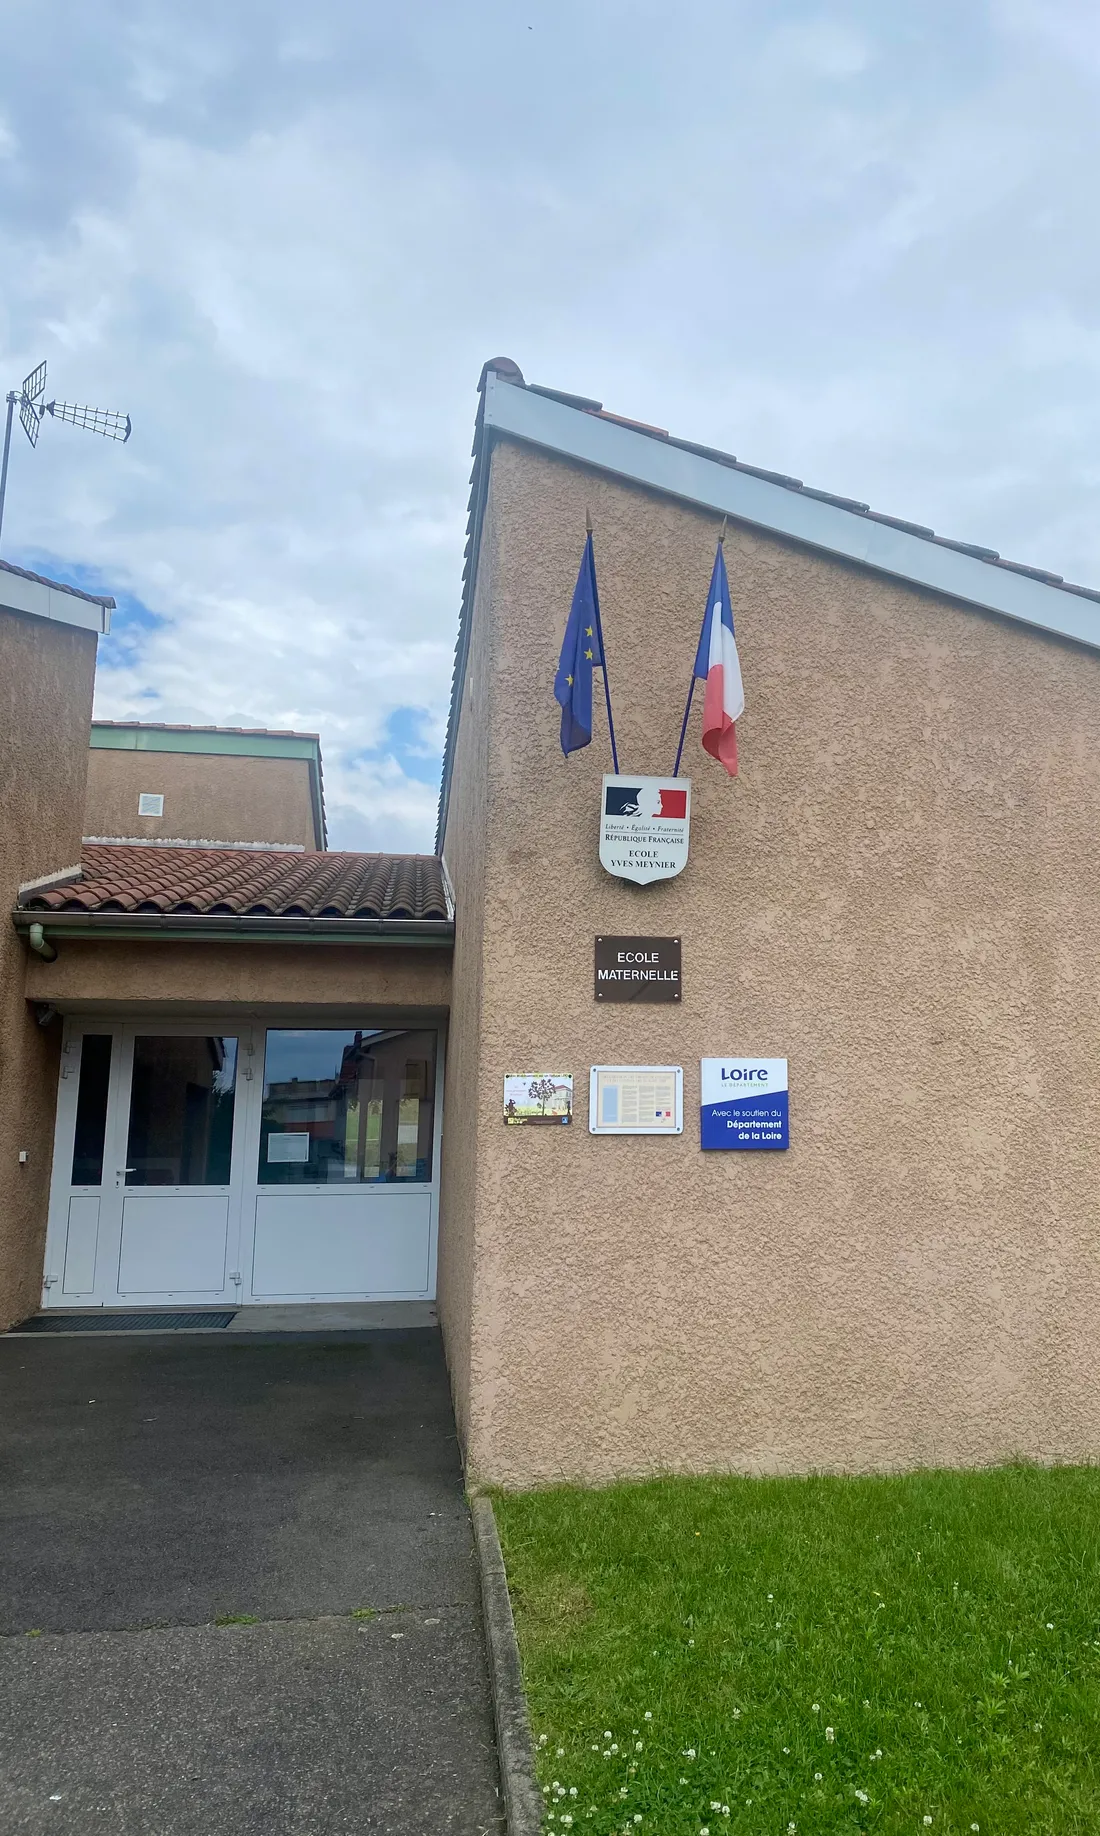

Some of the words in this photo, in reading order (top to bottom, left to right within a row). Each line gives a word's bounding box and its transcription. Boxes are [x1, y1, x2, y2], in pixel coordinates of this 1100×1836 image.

[605, 833, 647, 843] RÉPUBLIQUE
[648, 835, 684, 845] FRANÇAISE
[629, 850, 659, 858] ECOLE
[635, 860, 676, 869] MEYNIER
[617, 952, 659, 963] ECOLE
[598, 969, 679, 981] MATERNELLE
[721, 1068, 768, 1081] Loire
[711, 1109, 732, 1117] Avec
[733, 1109, 740, 1117] le
[741, 1109, 769, 1117] soutien
[770, 1109, 782, 1117] du
[727, 1120, 782, 1130] Département
[738, 1132, 750, 1140] de
[751, 1132, 760, 1140] la
[761, 1132, 782, 1140] Loire
